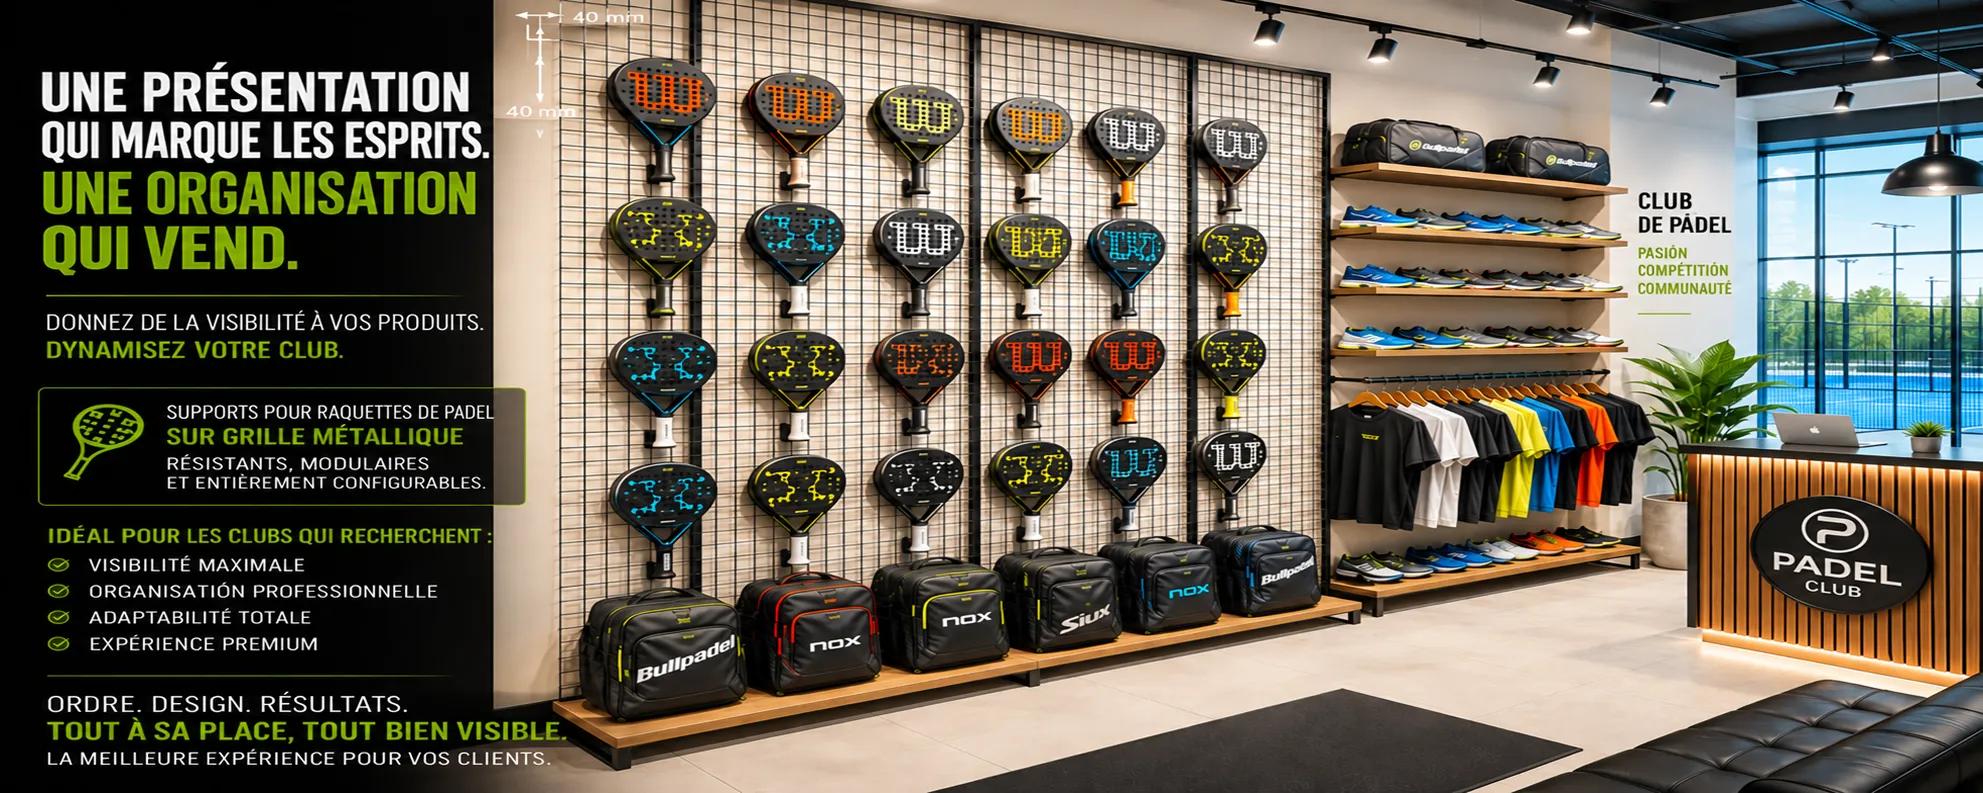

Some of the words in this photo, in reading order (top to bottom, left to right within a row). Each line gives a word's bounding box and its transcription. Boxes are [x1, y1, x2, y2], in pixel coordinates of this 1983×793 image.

[1638, 192, 1693, 210] CLUB
[1638, 216, 1664, 234] DE
[1637, 280, 1732, 295] COMMUNAUTÉ
[1773, 551, 1903, 587] PADEL
[1805, 580, 1862, 598] CLUB
[1059, 603, 1111, 635] Siux
[636, 634, 736, 684] Bullpadel
